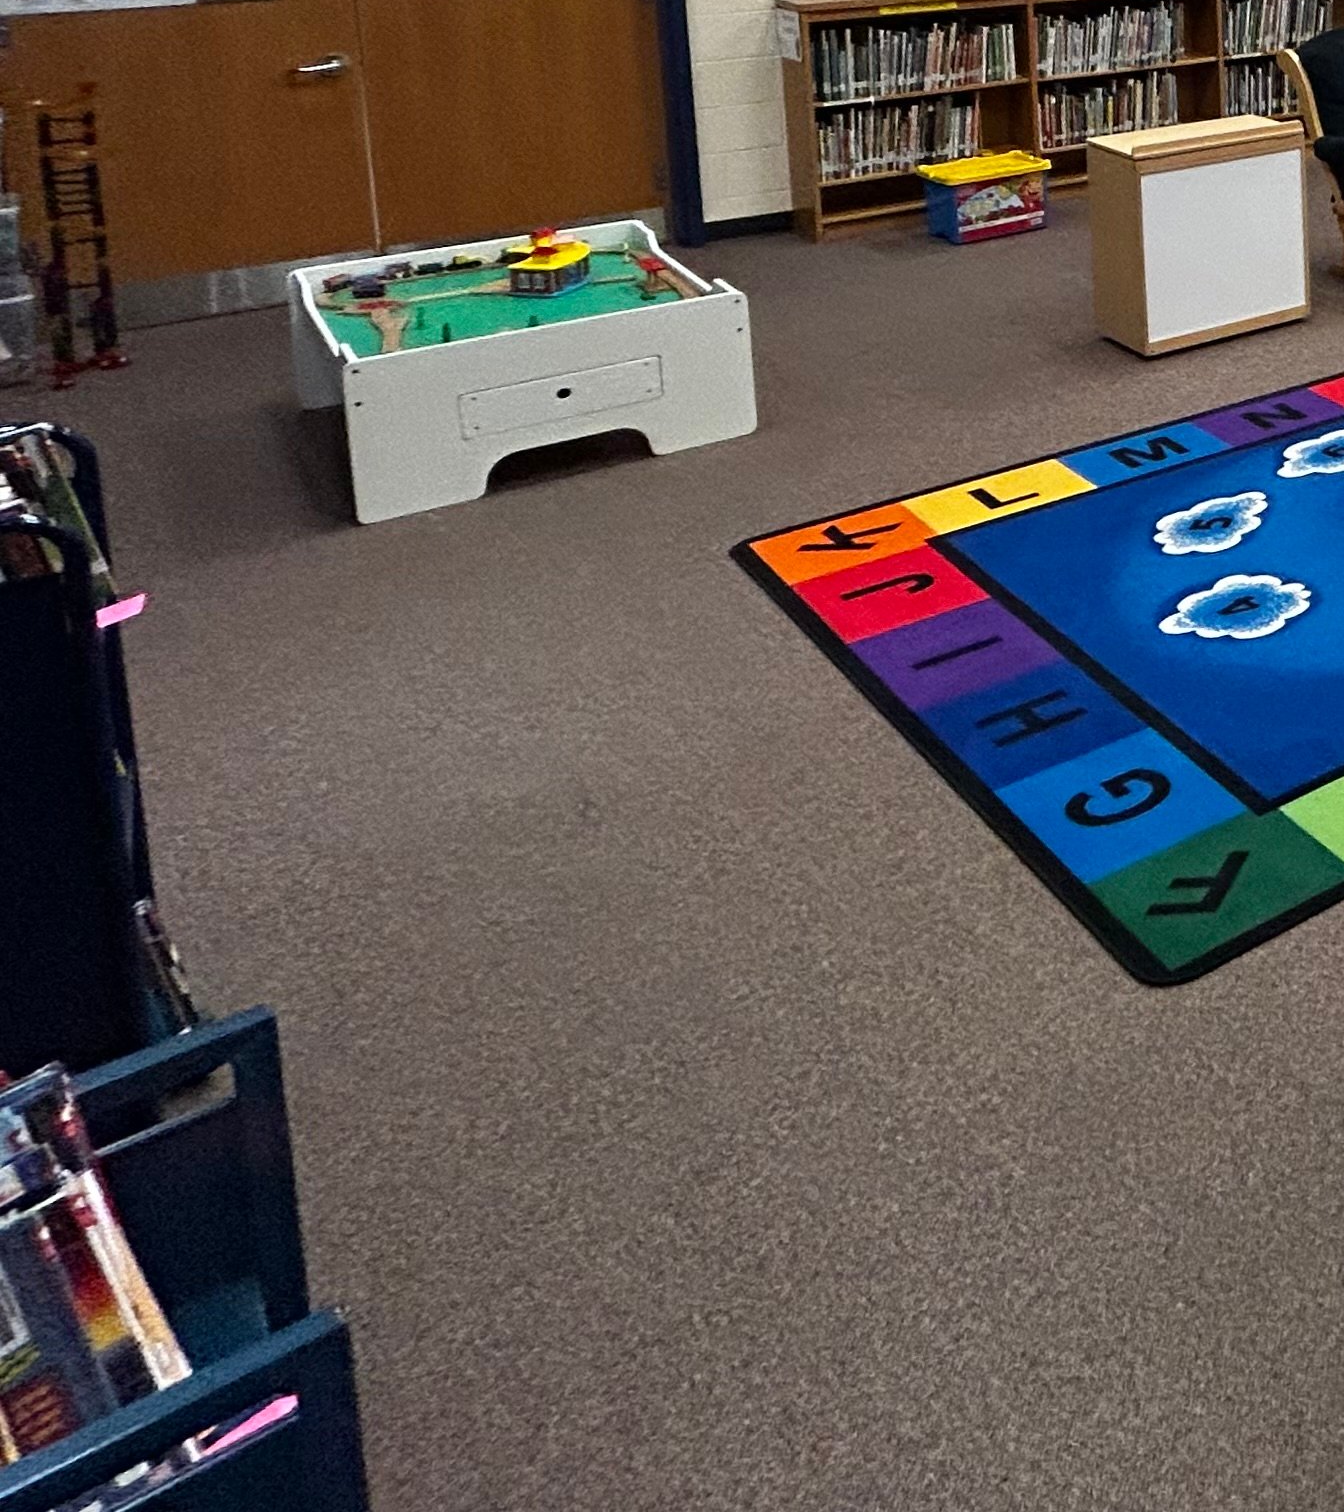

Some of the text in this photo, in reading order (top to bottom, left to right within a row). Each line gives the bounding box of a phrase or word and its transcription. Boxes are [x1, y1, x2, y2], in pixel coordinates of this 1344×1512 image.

[797, 525, 904, 552] K
[968, 488, 1039, 509] L
[1109, 437, 1190, 468] M
[1242, 402, 1309, 429] N
[1190, 517, 1232, 530] 5
[1217, 596, 1259, 615] 4
[840, 573, 934, 601] J
[975, 690, 1086, 748] H
[1064, 768, 1172, 828] G
[1146, 850, 1250, 916] F
